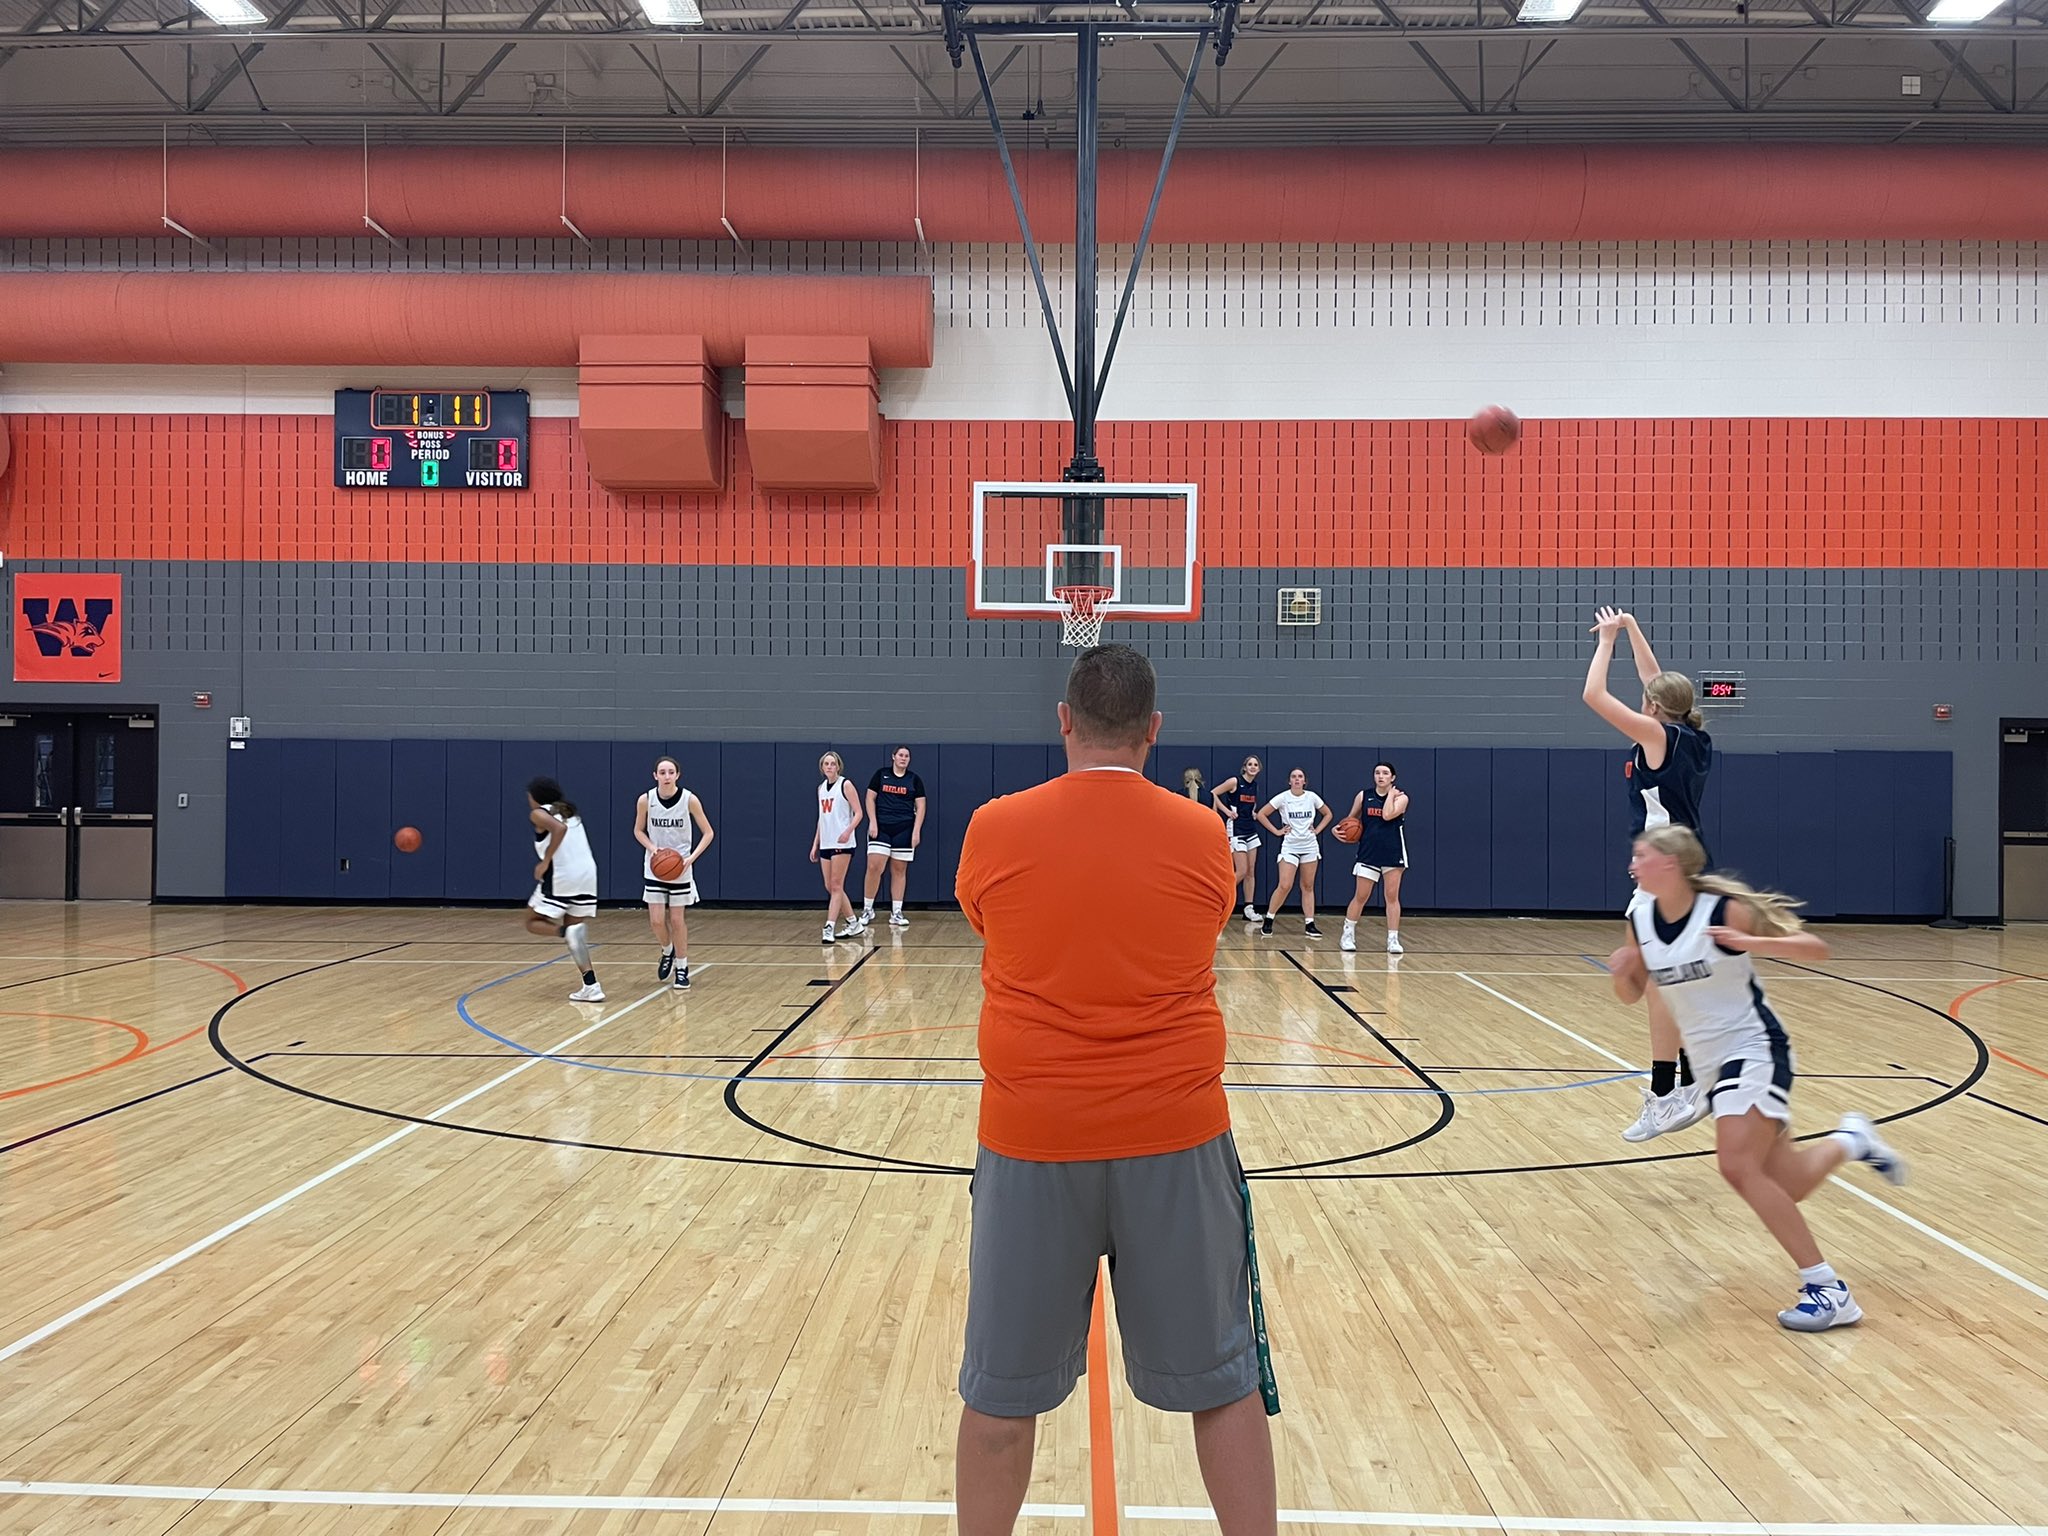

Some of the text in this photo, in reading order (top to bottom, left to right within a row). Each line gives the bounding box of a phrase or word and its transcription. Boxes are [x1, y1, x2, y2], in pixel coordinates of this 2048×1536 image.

[417, 431, 444, 439] BONUS
[420, 440, 441, 448] POSS
[371, 439, 390, 469] 0
[411, 449, 450, 460] PERIOD
[498, 439, 517, 470] 0
[345, 471, 388, 486] HOME
[423, 461, 438, 485] 0
[465, 471, 523, 487] VISITOR
[22, 598, 113, 657] W
[821, 798, 834, 813] W
[651, 818, 684, 828] WAKELAND
